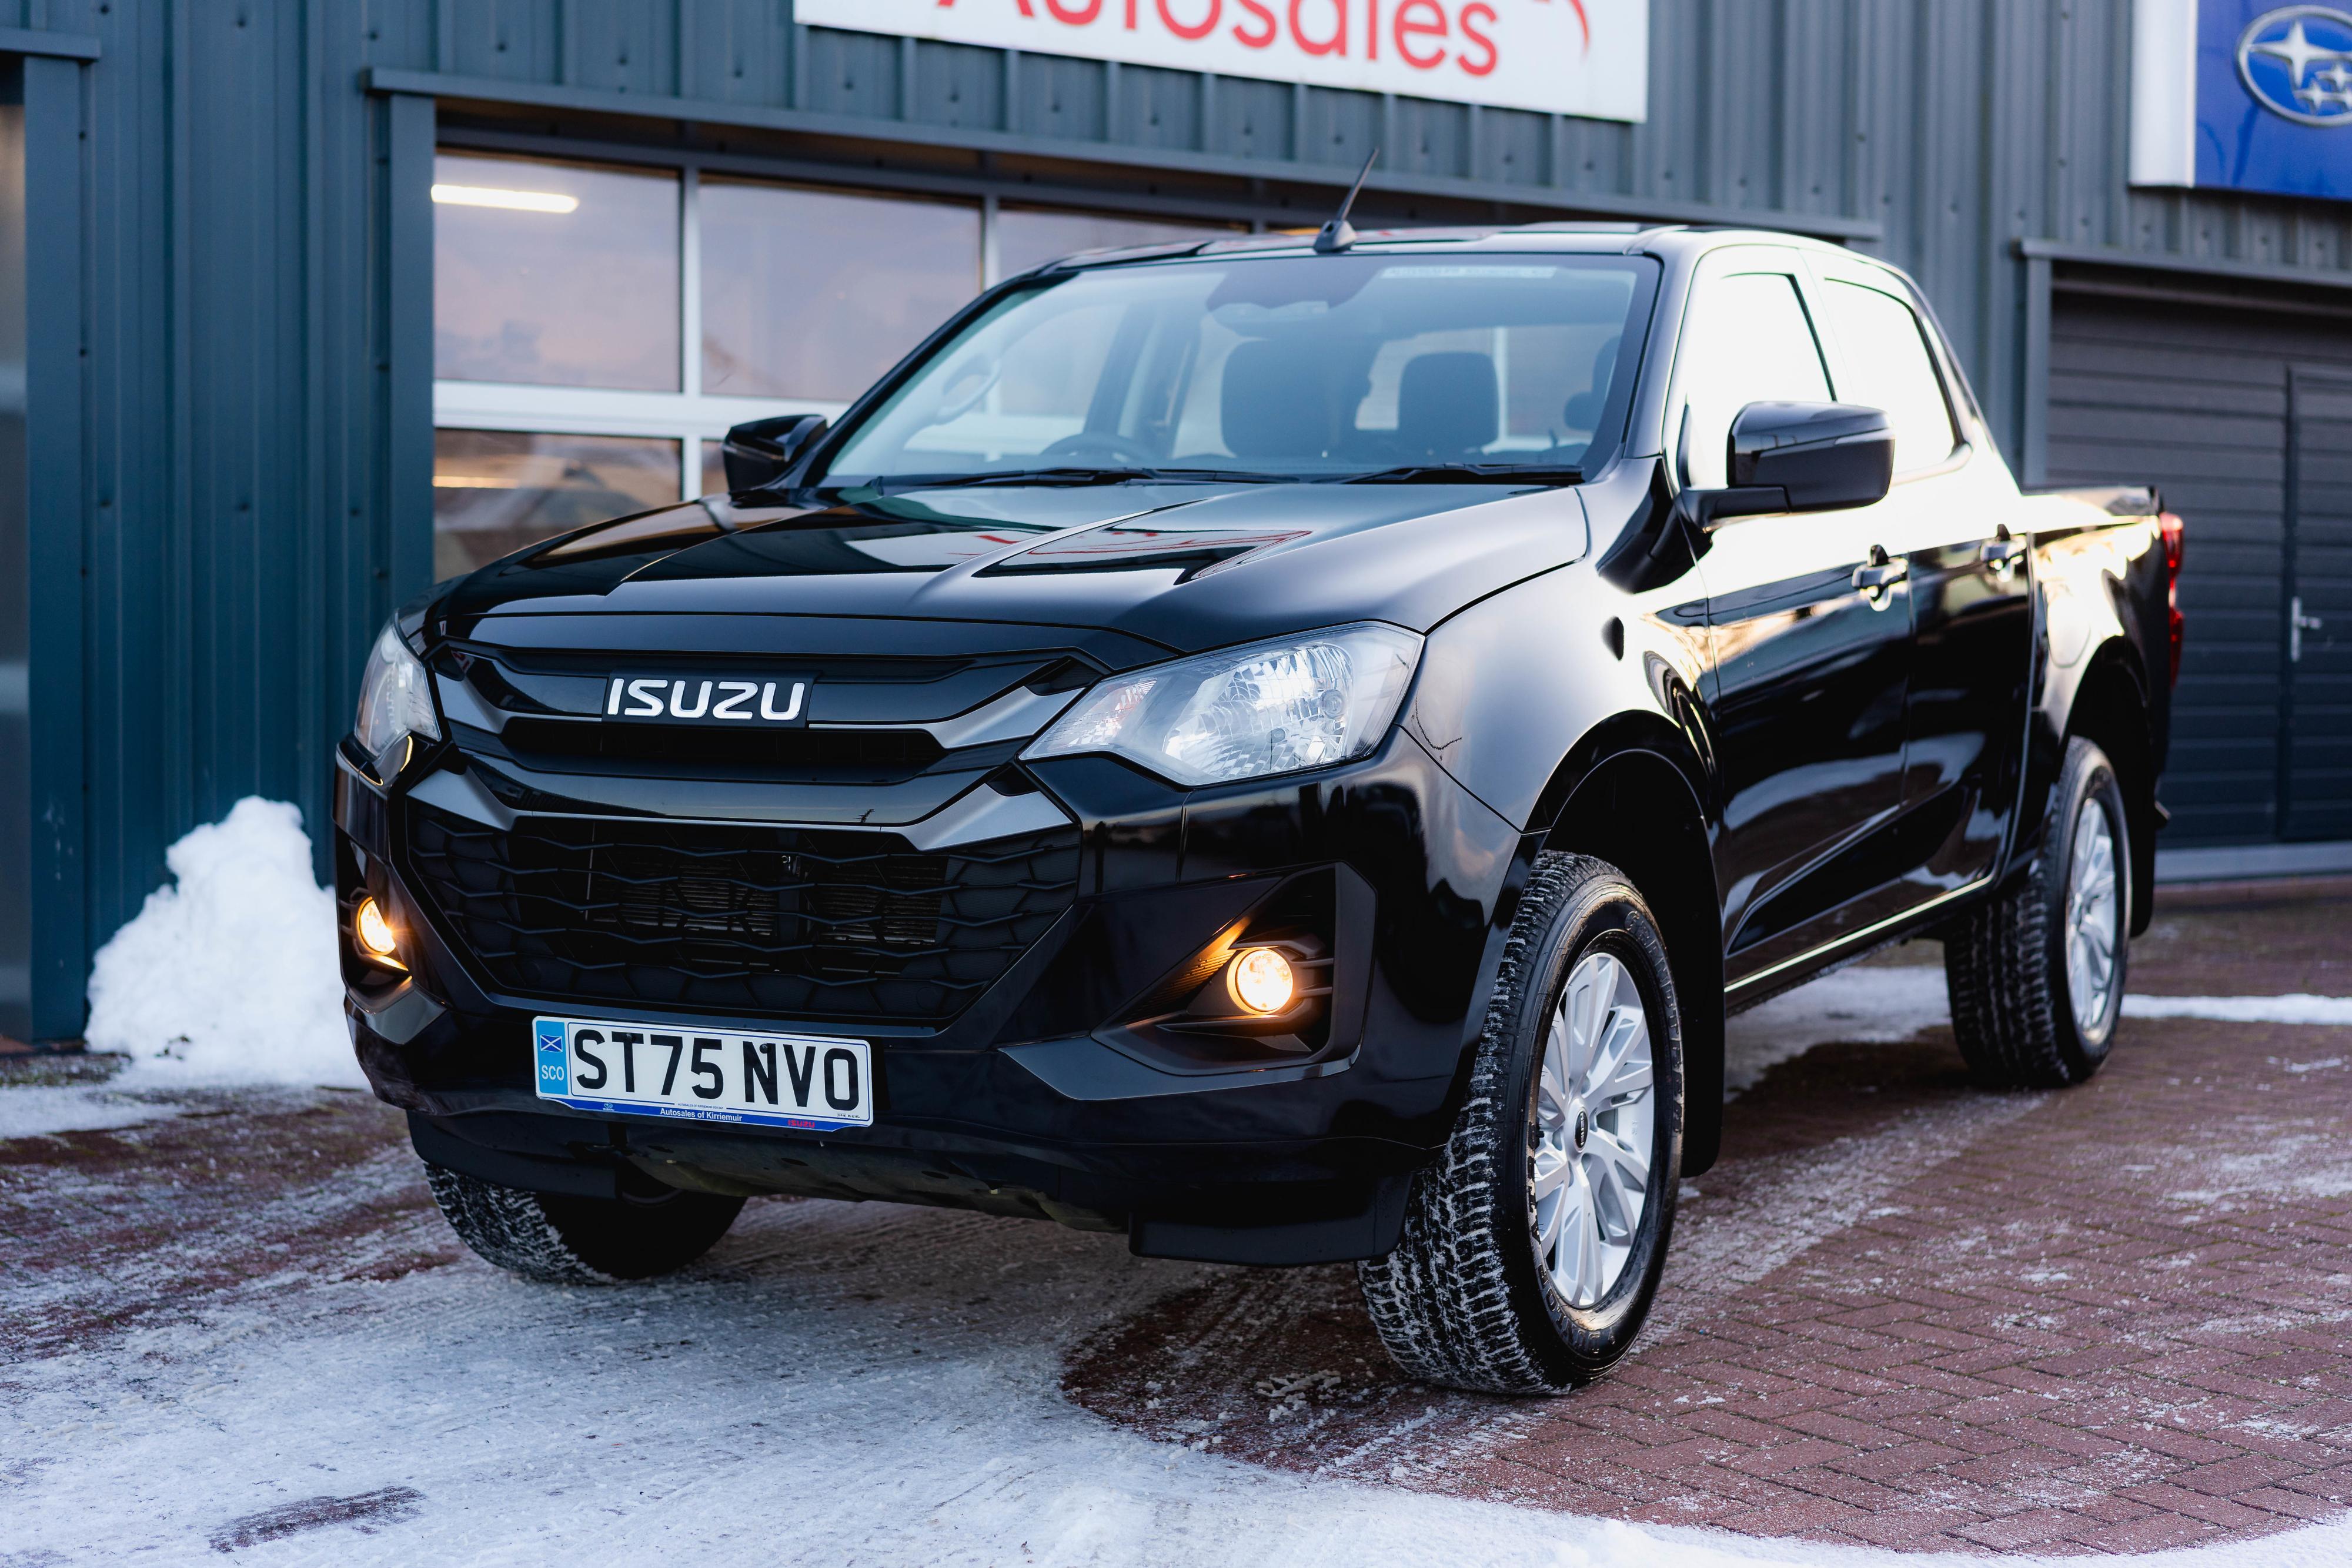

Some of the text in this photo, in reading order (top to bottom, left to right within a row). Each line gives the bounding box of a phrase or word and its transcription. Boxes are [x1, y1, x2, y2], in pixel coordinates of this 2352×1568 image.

[937, 0, 1499, 76] osales
[607, 678, 805, 721] ISUZU
[541, 1065, 564, 1081] SCO
[573, 1029, 860, 1111] ST75 NVO
[660, 1108, 696, 1118] Autosales
[706, 1112, 743, 1122] Kirriemuir
[788, 1119, 816, 1128] ISUZU
[1538, 1263, 1601, 1354] DUNLOP
